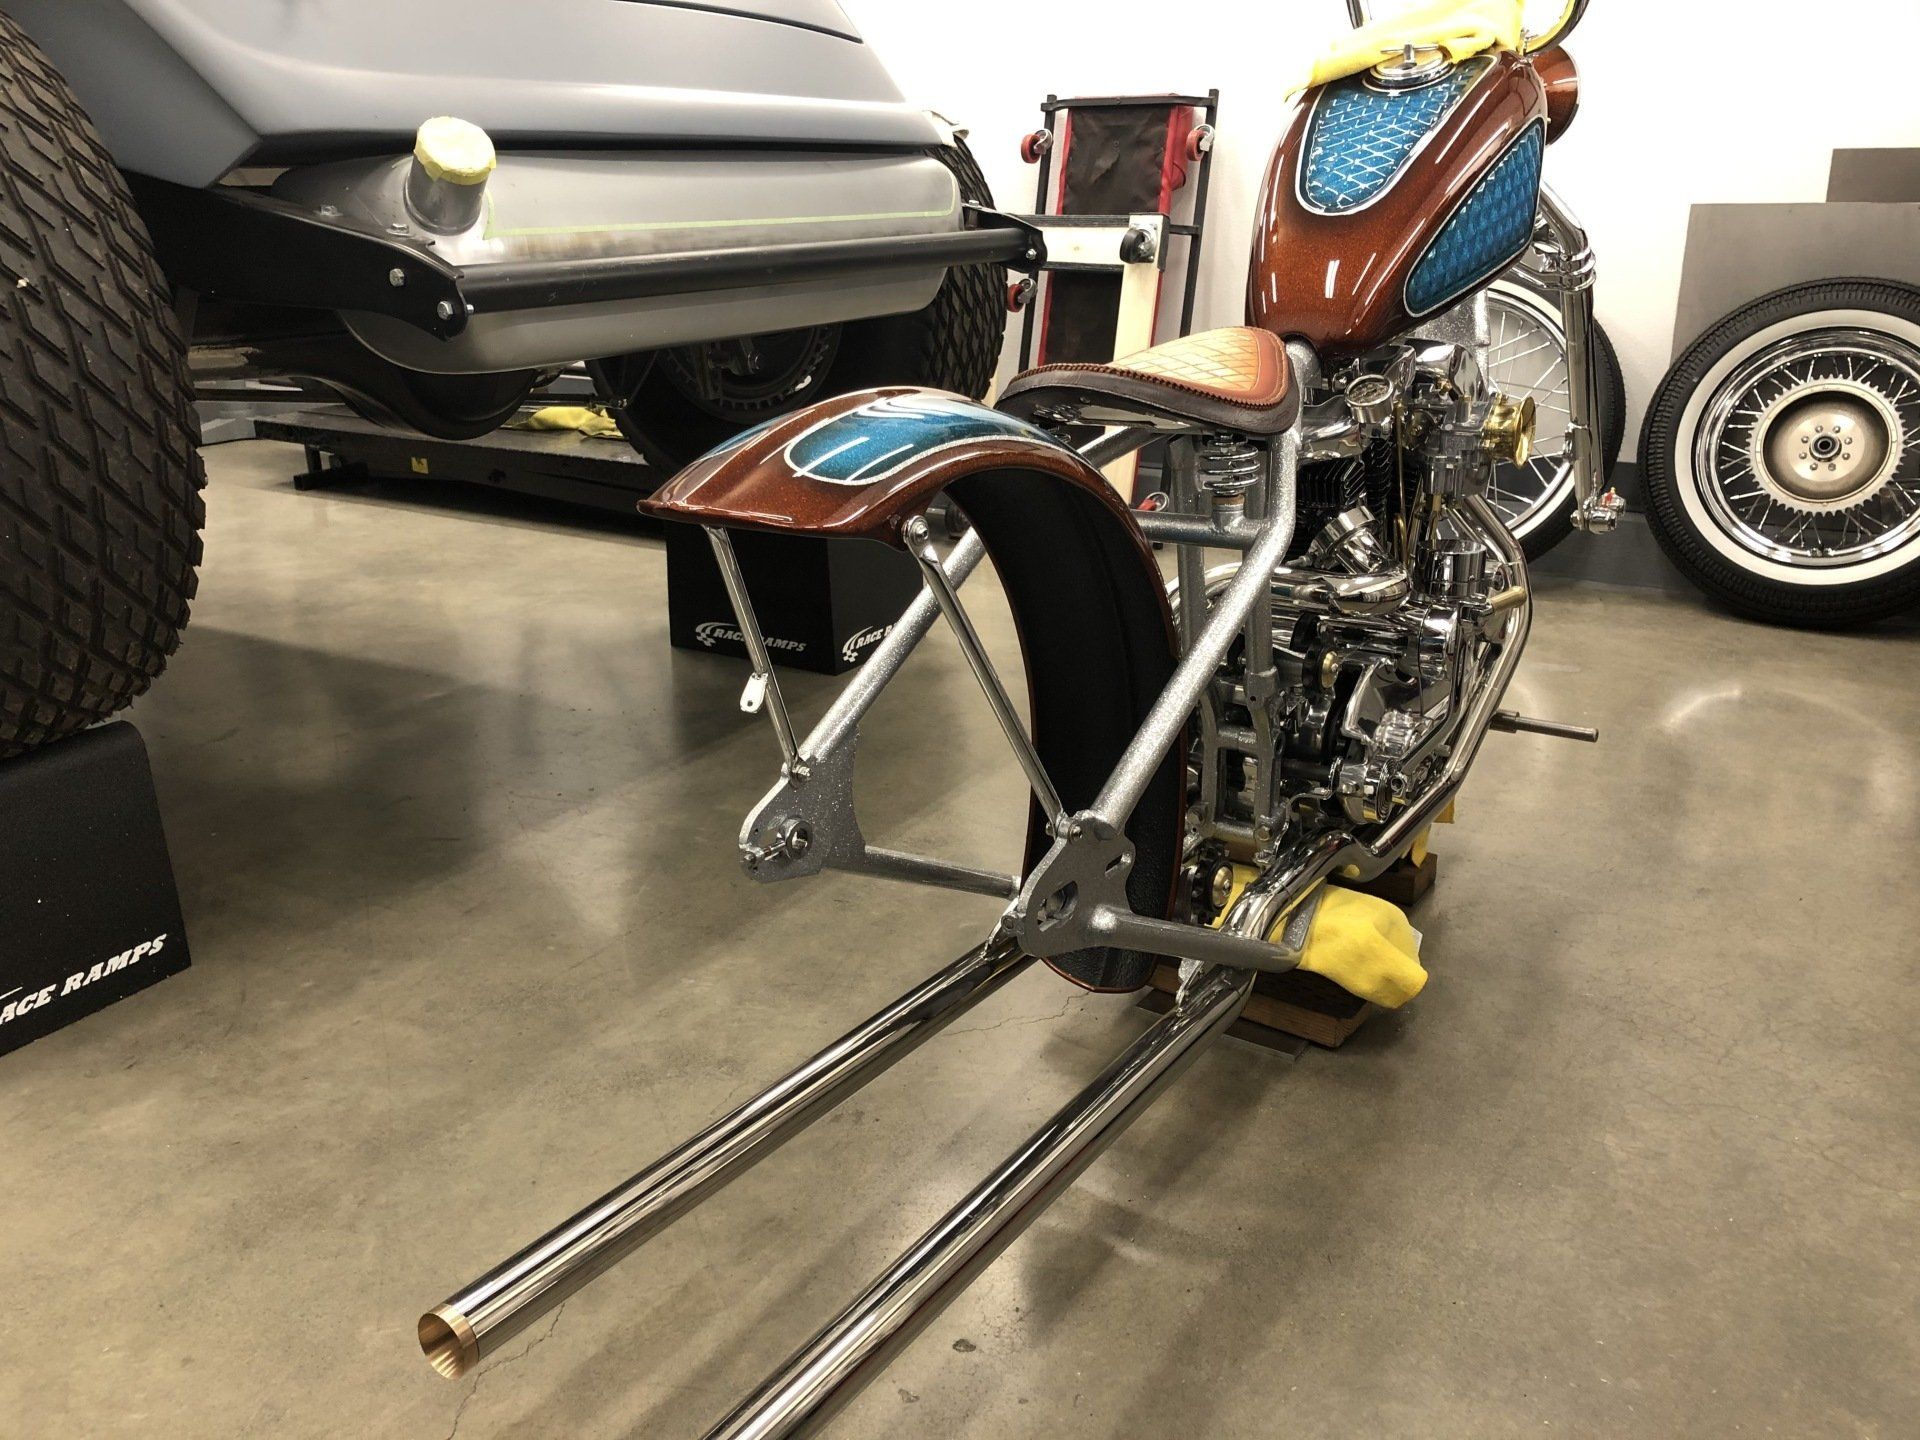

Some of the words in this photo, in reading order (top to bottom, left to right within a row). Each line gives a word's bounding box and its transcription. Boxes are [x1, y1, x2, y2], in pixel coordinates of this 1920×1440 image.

[713, 628, 745, 642] RAC
[762, 636, 807, 652] AMPS
[856, 629, 884, 649] RACE
[0, 984, 57, 1025] ACE
[60, 933, 167, 996] RAMPS
